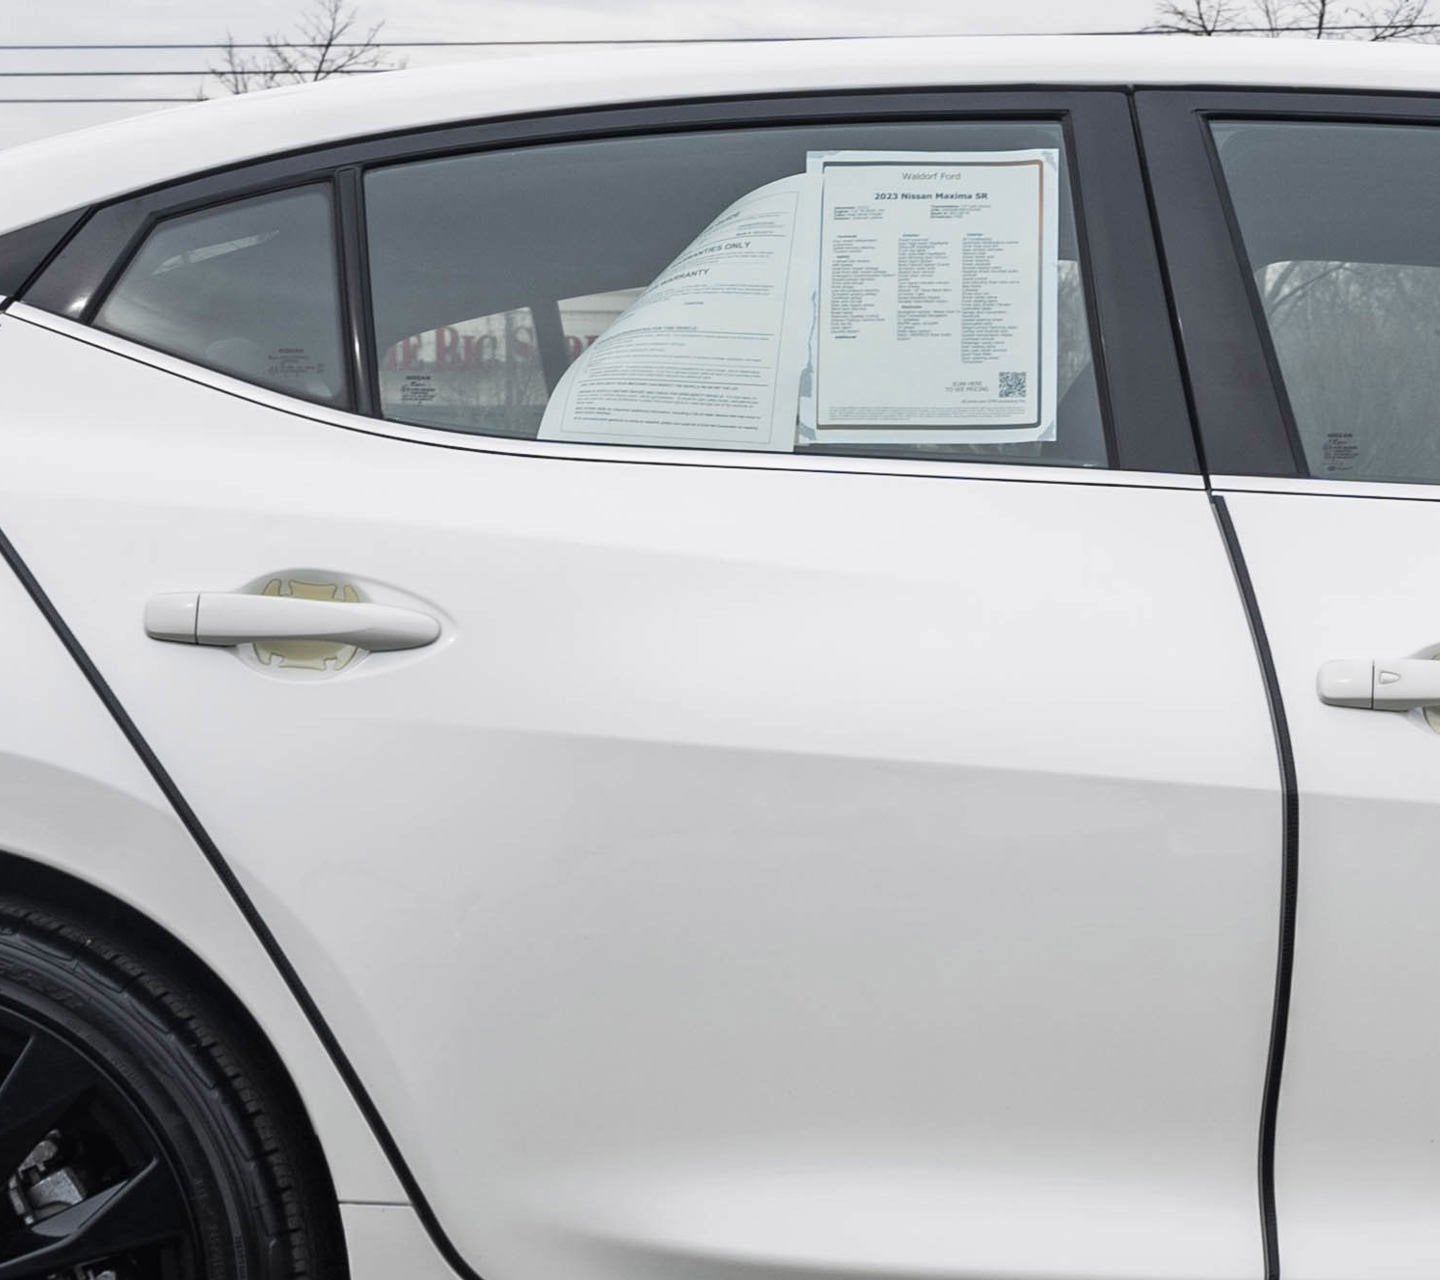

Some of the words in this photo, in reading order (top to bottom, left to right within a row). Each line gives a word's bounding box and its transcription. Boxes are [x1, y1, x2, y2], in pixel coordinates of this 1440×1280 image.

[902, 172, 937, 180] Waldorf
[940, 172, 961, 180] Ford
[901, 192, 932, 200] Nissan
[935, 192, 973, 200] Maxima
[725, 241, 751, 250] ONLY
